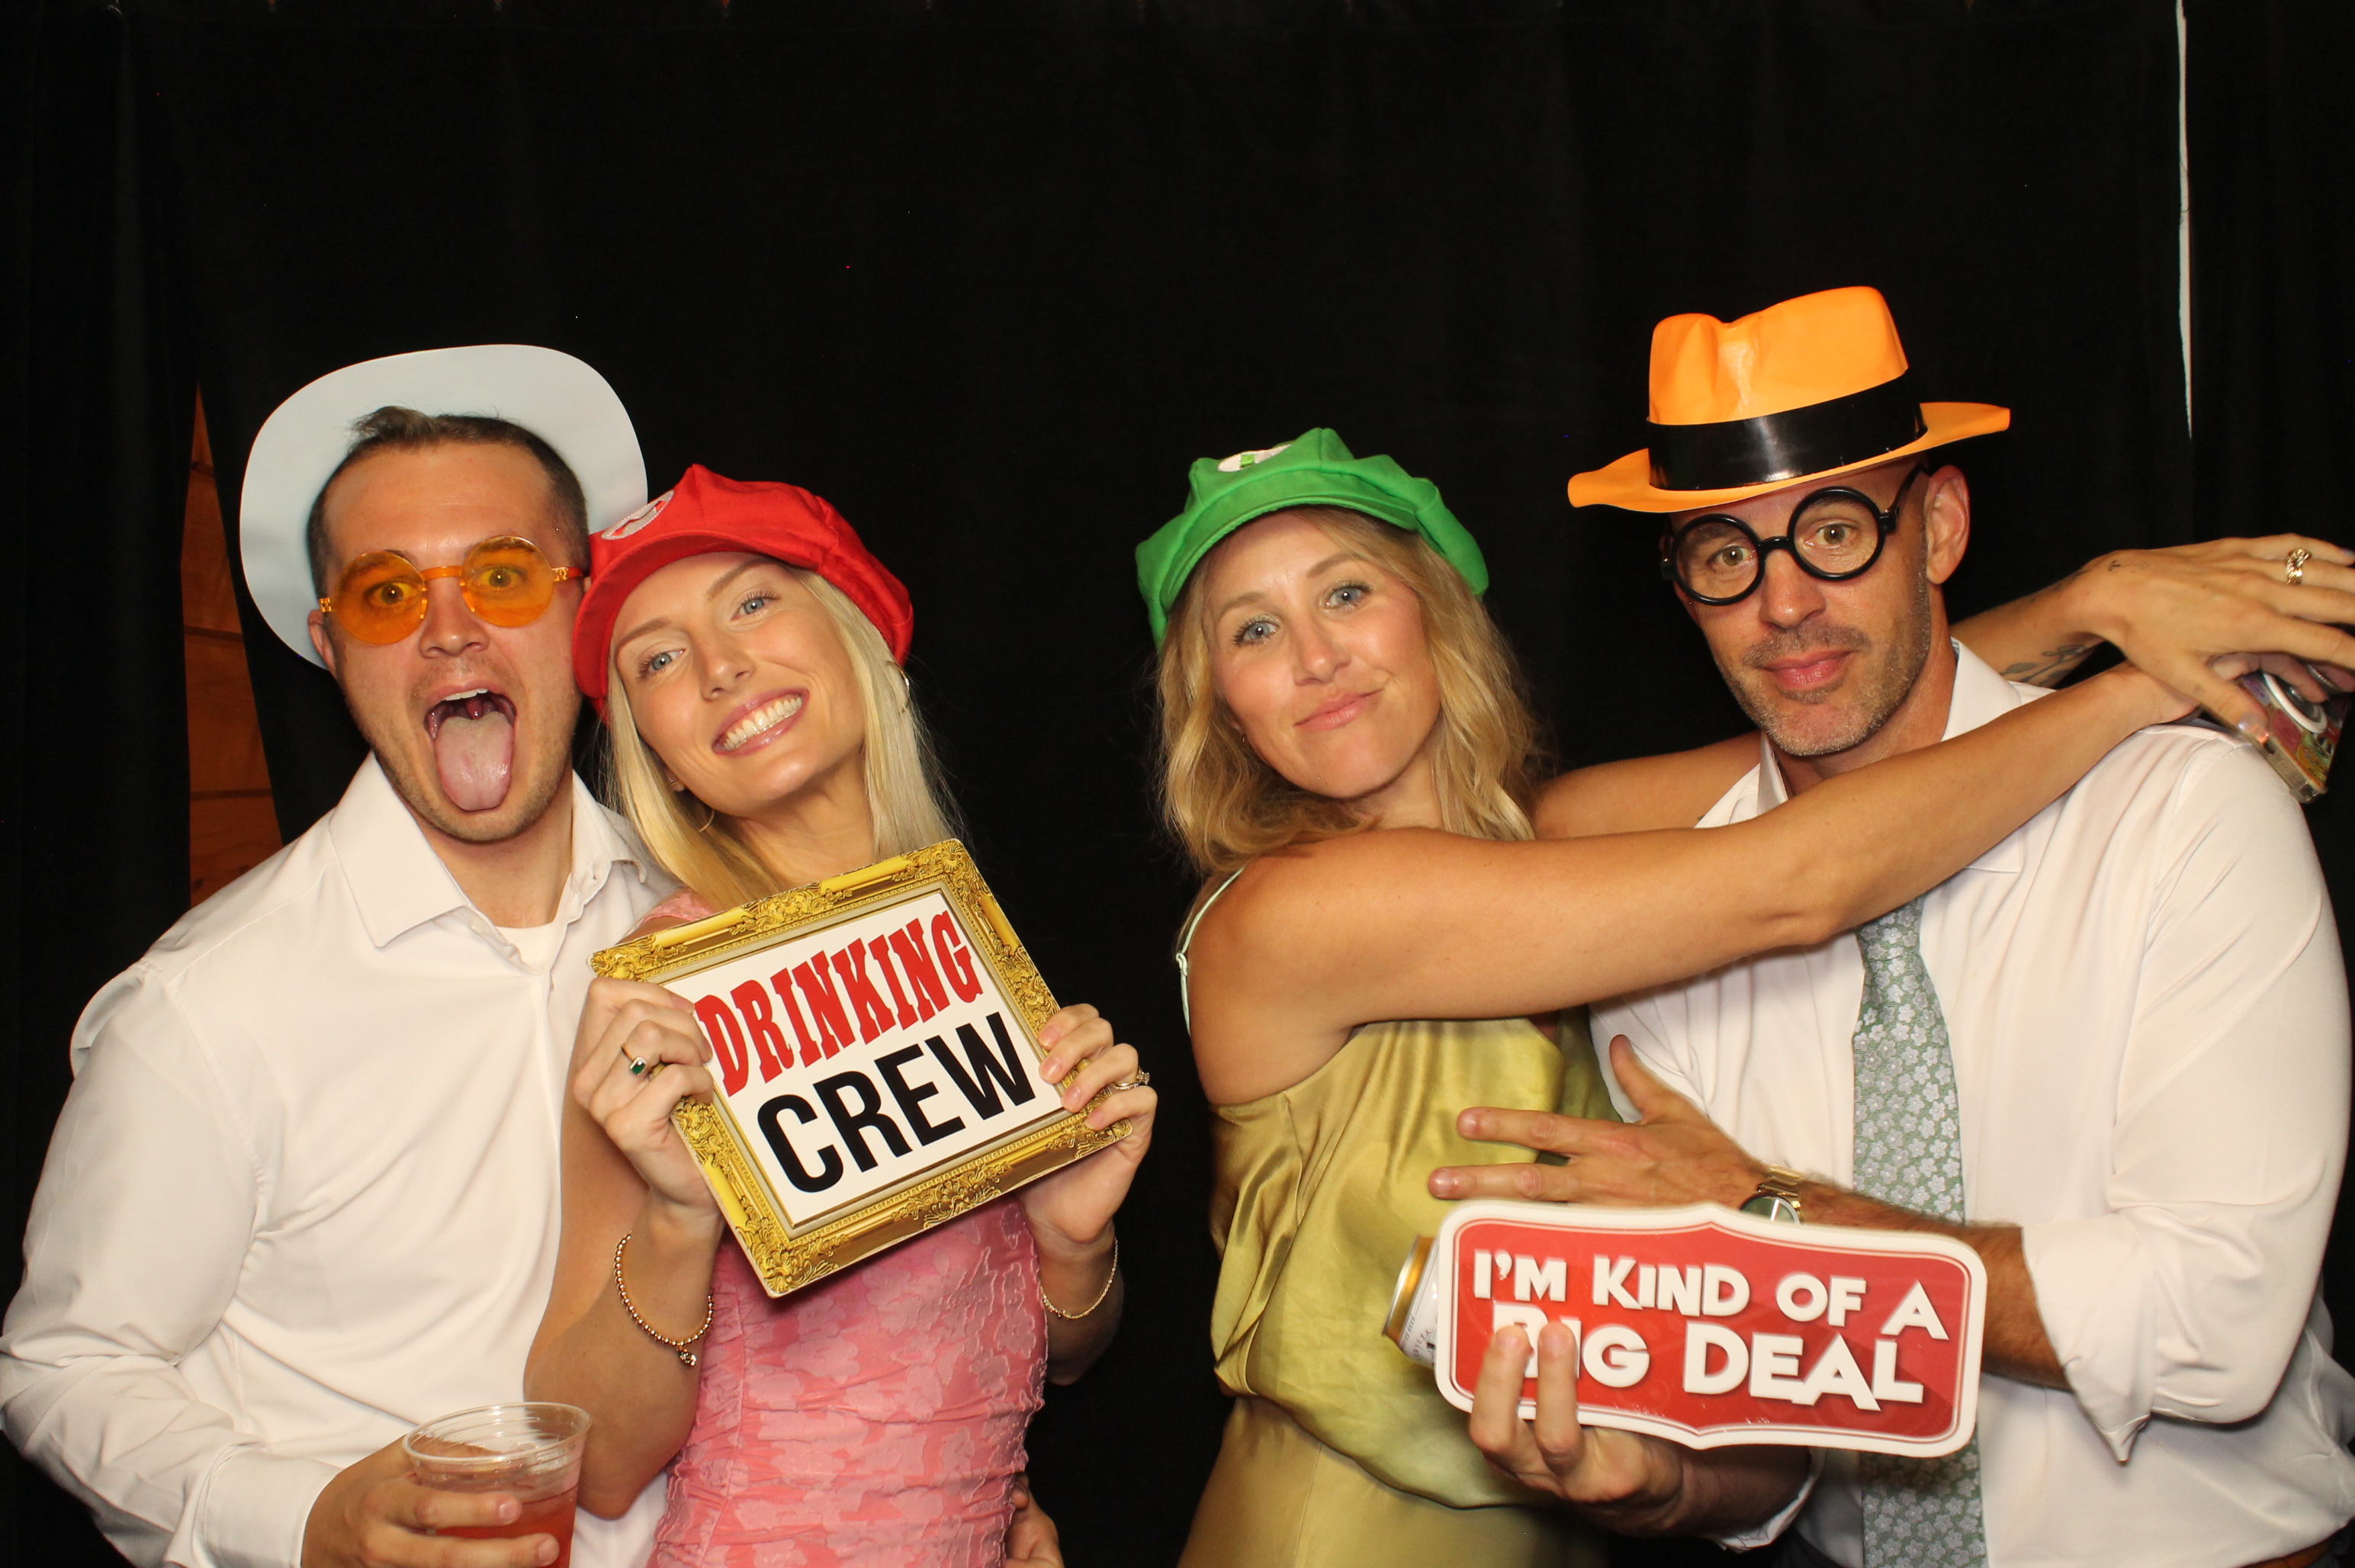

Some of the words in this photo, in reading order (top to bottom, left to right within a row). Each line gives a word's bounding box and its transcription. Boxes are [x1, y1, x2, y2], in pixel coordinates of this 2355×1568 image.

[693, 911, 984, 1097] DRINKING
[757, 1012, 1037, 1194] CREW
[1473, 1248, 1567, 1302] I'M
[1592, 1254, 1750, 1317] KIND
[1775, 1271, 1867, 1327] OF
[1881, 1280, 1949, 1341] A
[1683, 1320, 1924, 1412] DEAL
